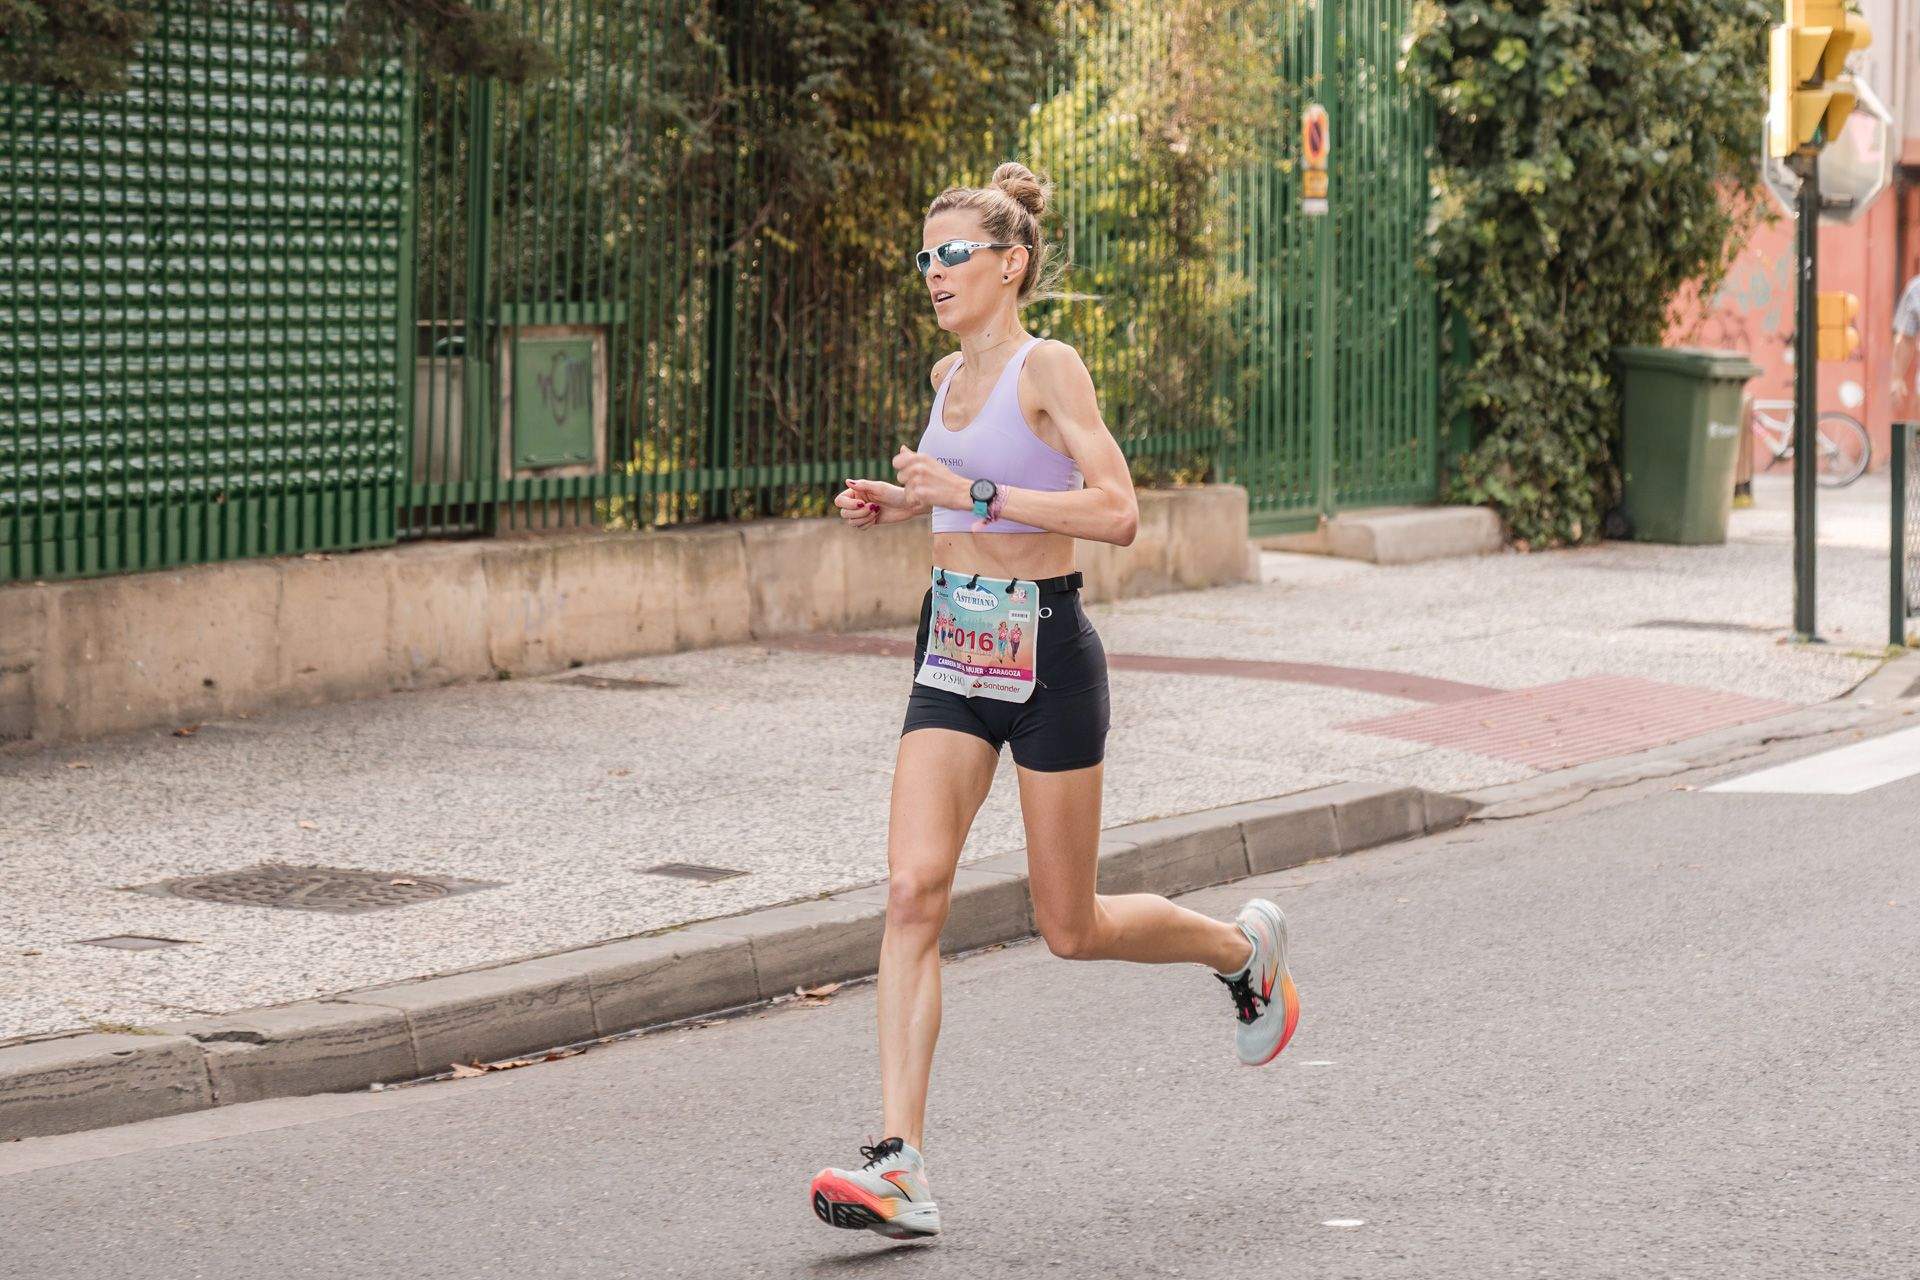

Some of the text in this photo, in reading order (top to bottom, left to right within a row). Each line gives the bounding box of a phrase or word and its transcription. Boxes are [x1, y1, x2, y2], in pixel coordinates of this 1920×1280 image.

[955, 628, 994, 651] 016
[967, 655, 972, 663] 3
[989, 668, 1021, 677] ZARAGOZA
[983, 682, 1021, 693] Santander
